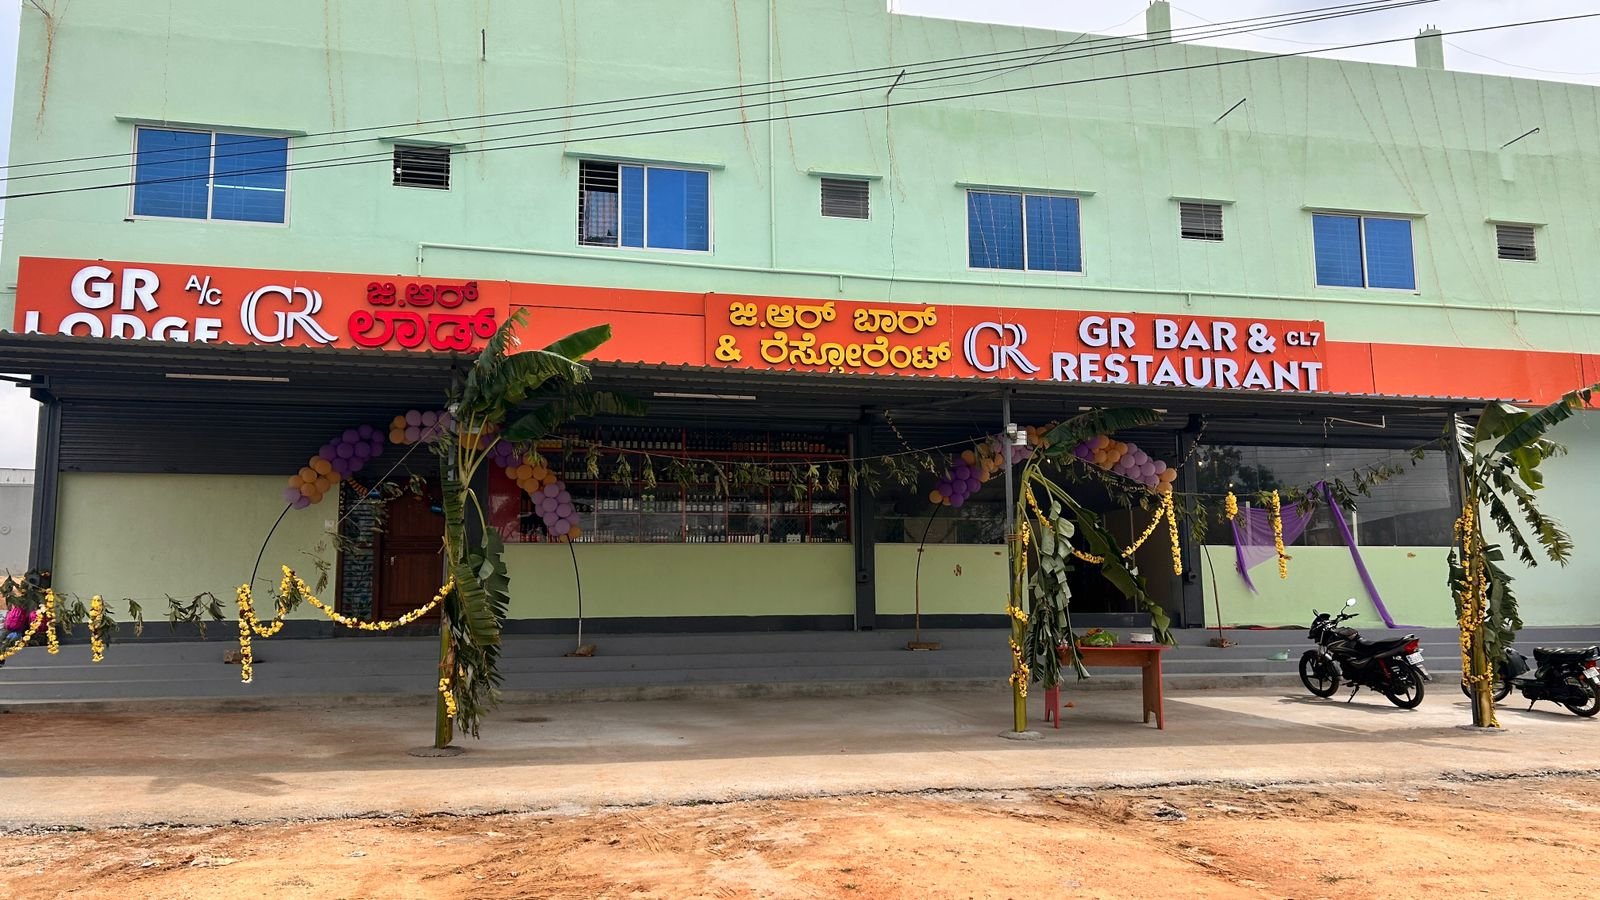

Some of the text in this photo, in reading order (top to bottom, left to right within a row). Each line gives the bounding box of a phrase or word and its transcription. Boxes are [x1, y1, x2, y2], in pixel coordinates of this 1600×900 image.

[71, 265, 222, 312] GR A/C
[367, 281, 479, 309] ಜಿ.ಆರ್
[239, 284, 339, 344] GR
[348, 307, 498, 353] ಲಾಡ್್
[729, 301, 938, 335] ಜಿ.ಆರ್ ಬಾರ್
[714, 334, 744, 363] &
[964, 321, 1041, 374] GR
[1079, 315, 1321, 354] GR BAR & CL7
[1051, 351, 1323, 391] RESTAURANT
